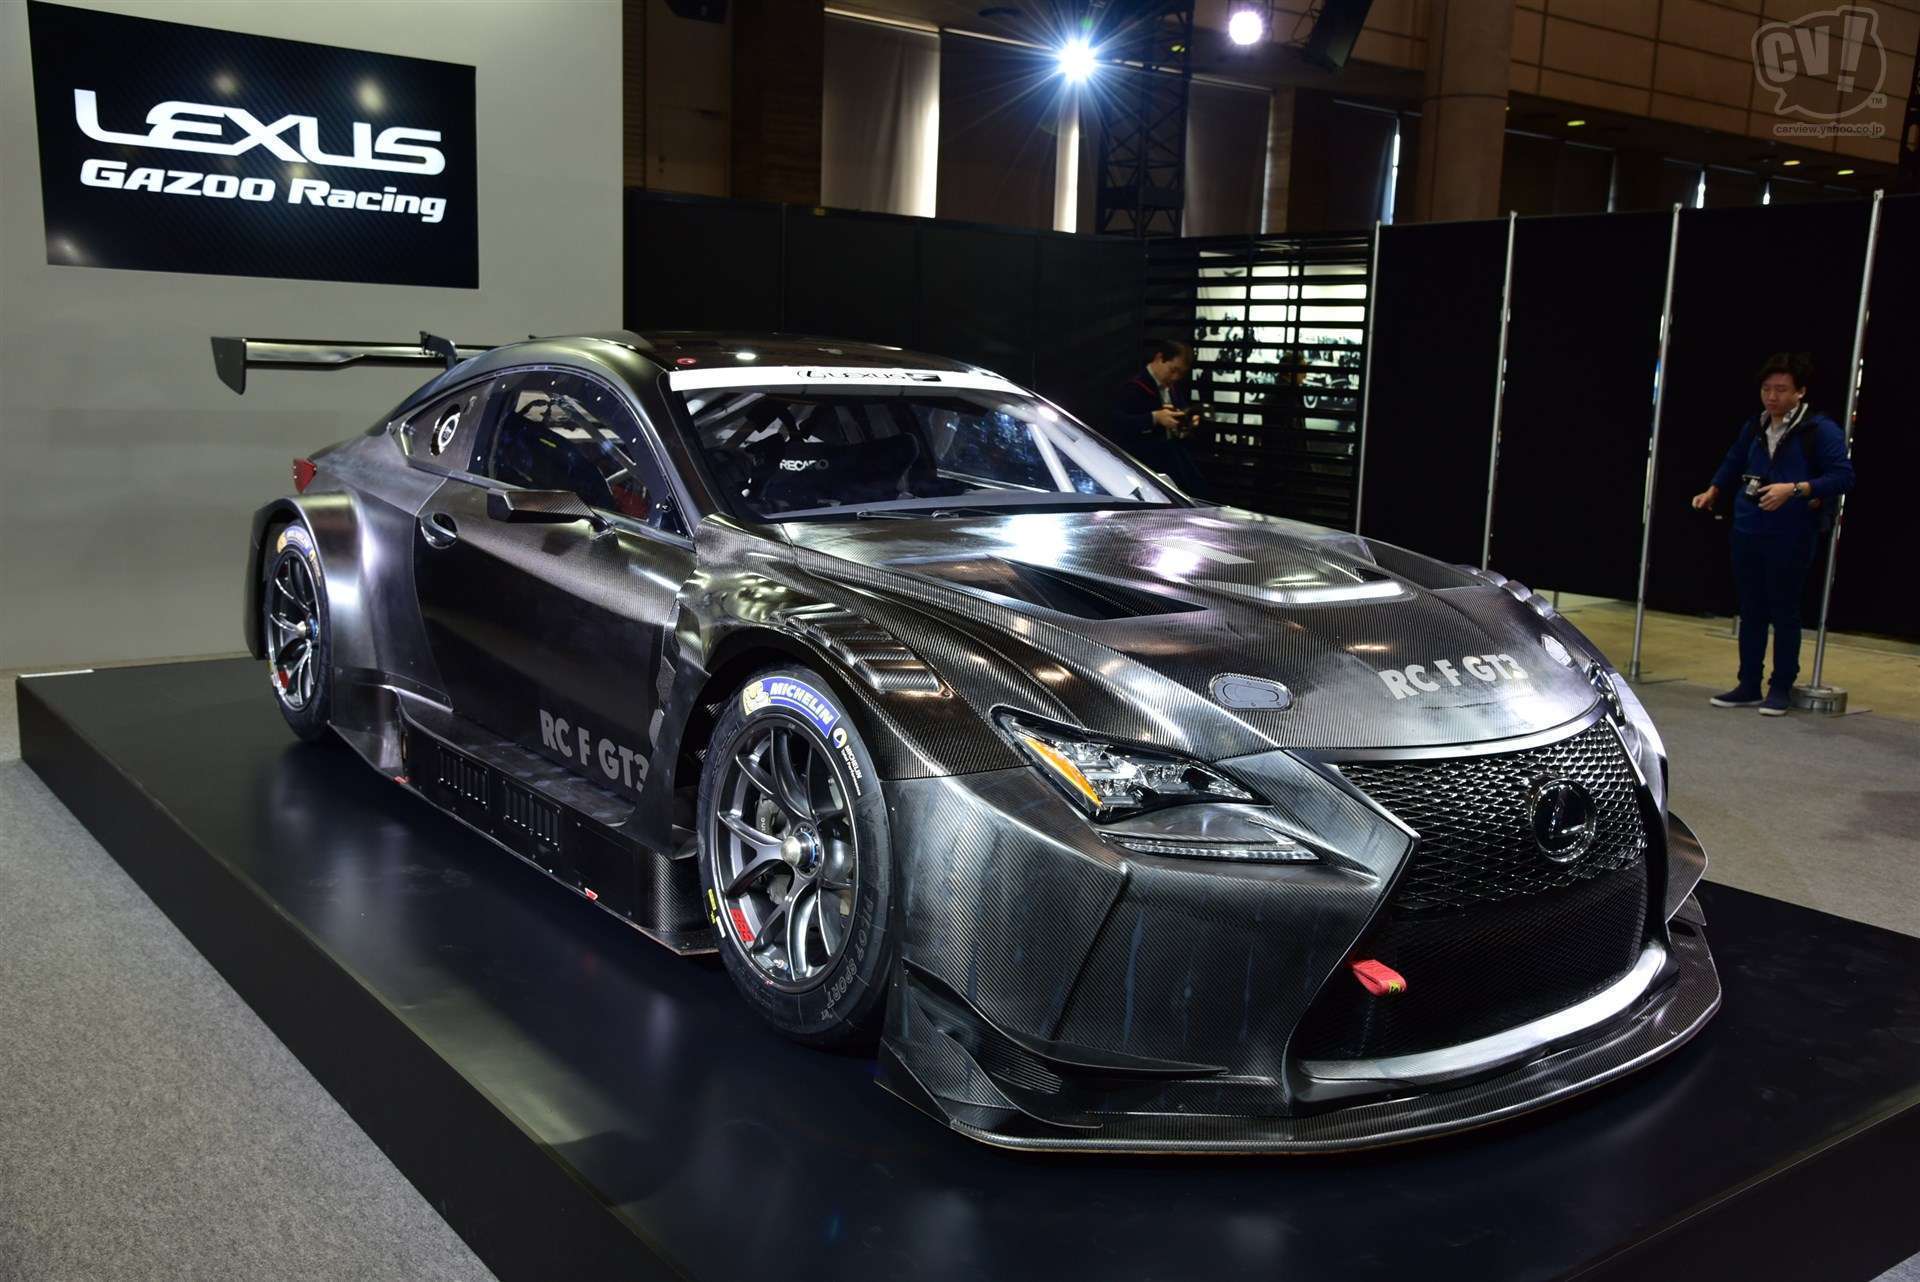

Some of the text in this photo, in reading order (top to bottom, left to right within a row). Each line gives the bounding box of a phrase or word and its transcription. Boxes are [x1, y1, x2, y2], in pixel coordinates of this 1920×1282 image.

[74, 88, 446, 176] LEXUS
[80, 158, 447, 223] GAZOO Racing
[770, 682, 834, 725] MICHELIN
[1378, 654, 1529, 700] RC F GT3
[539, 709, 573, 758] RC
[578, 726, 590, 766] F
